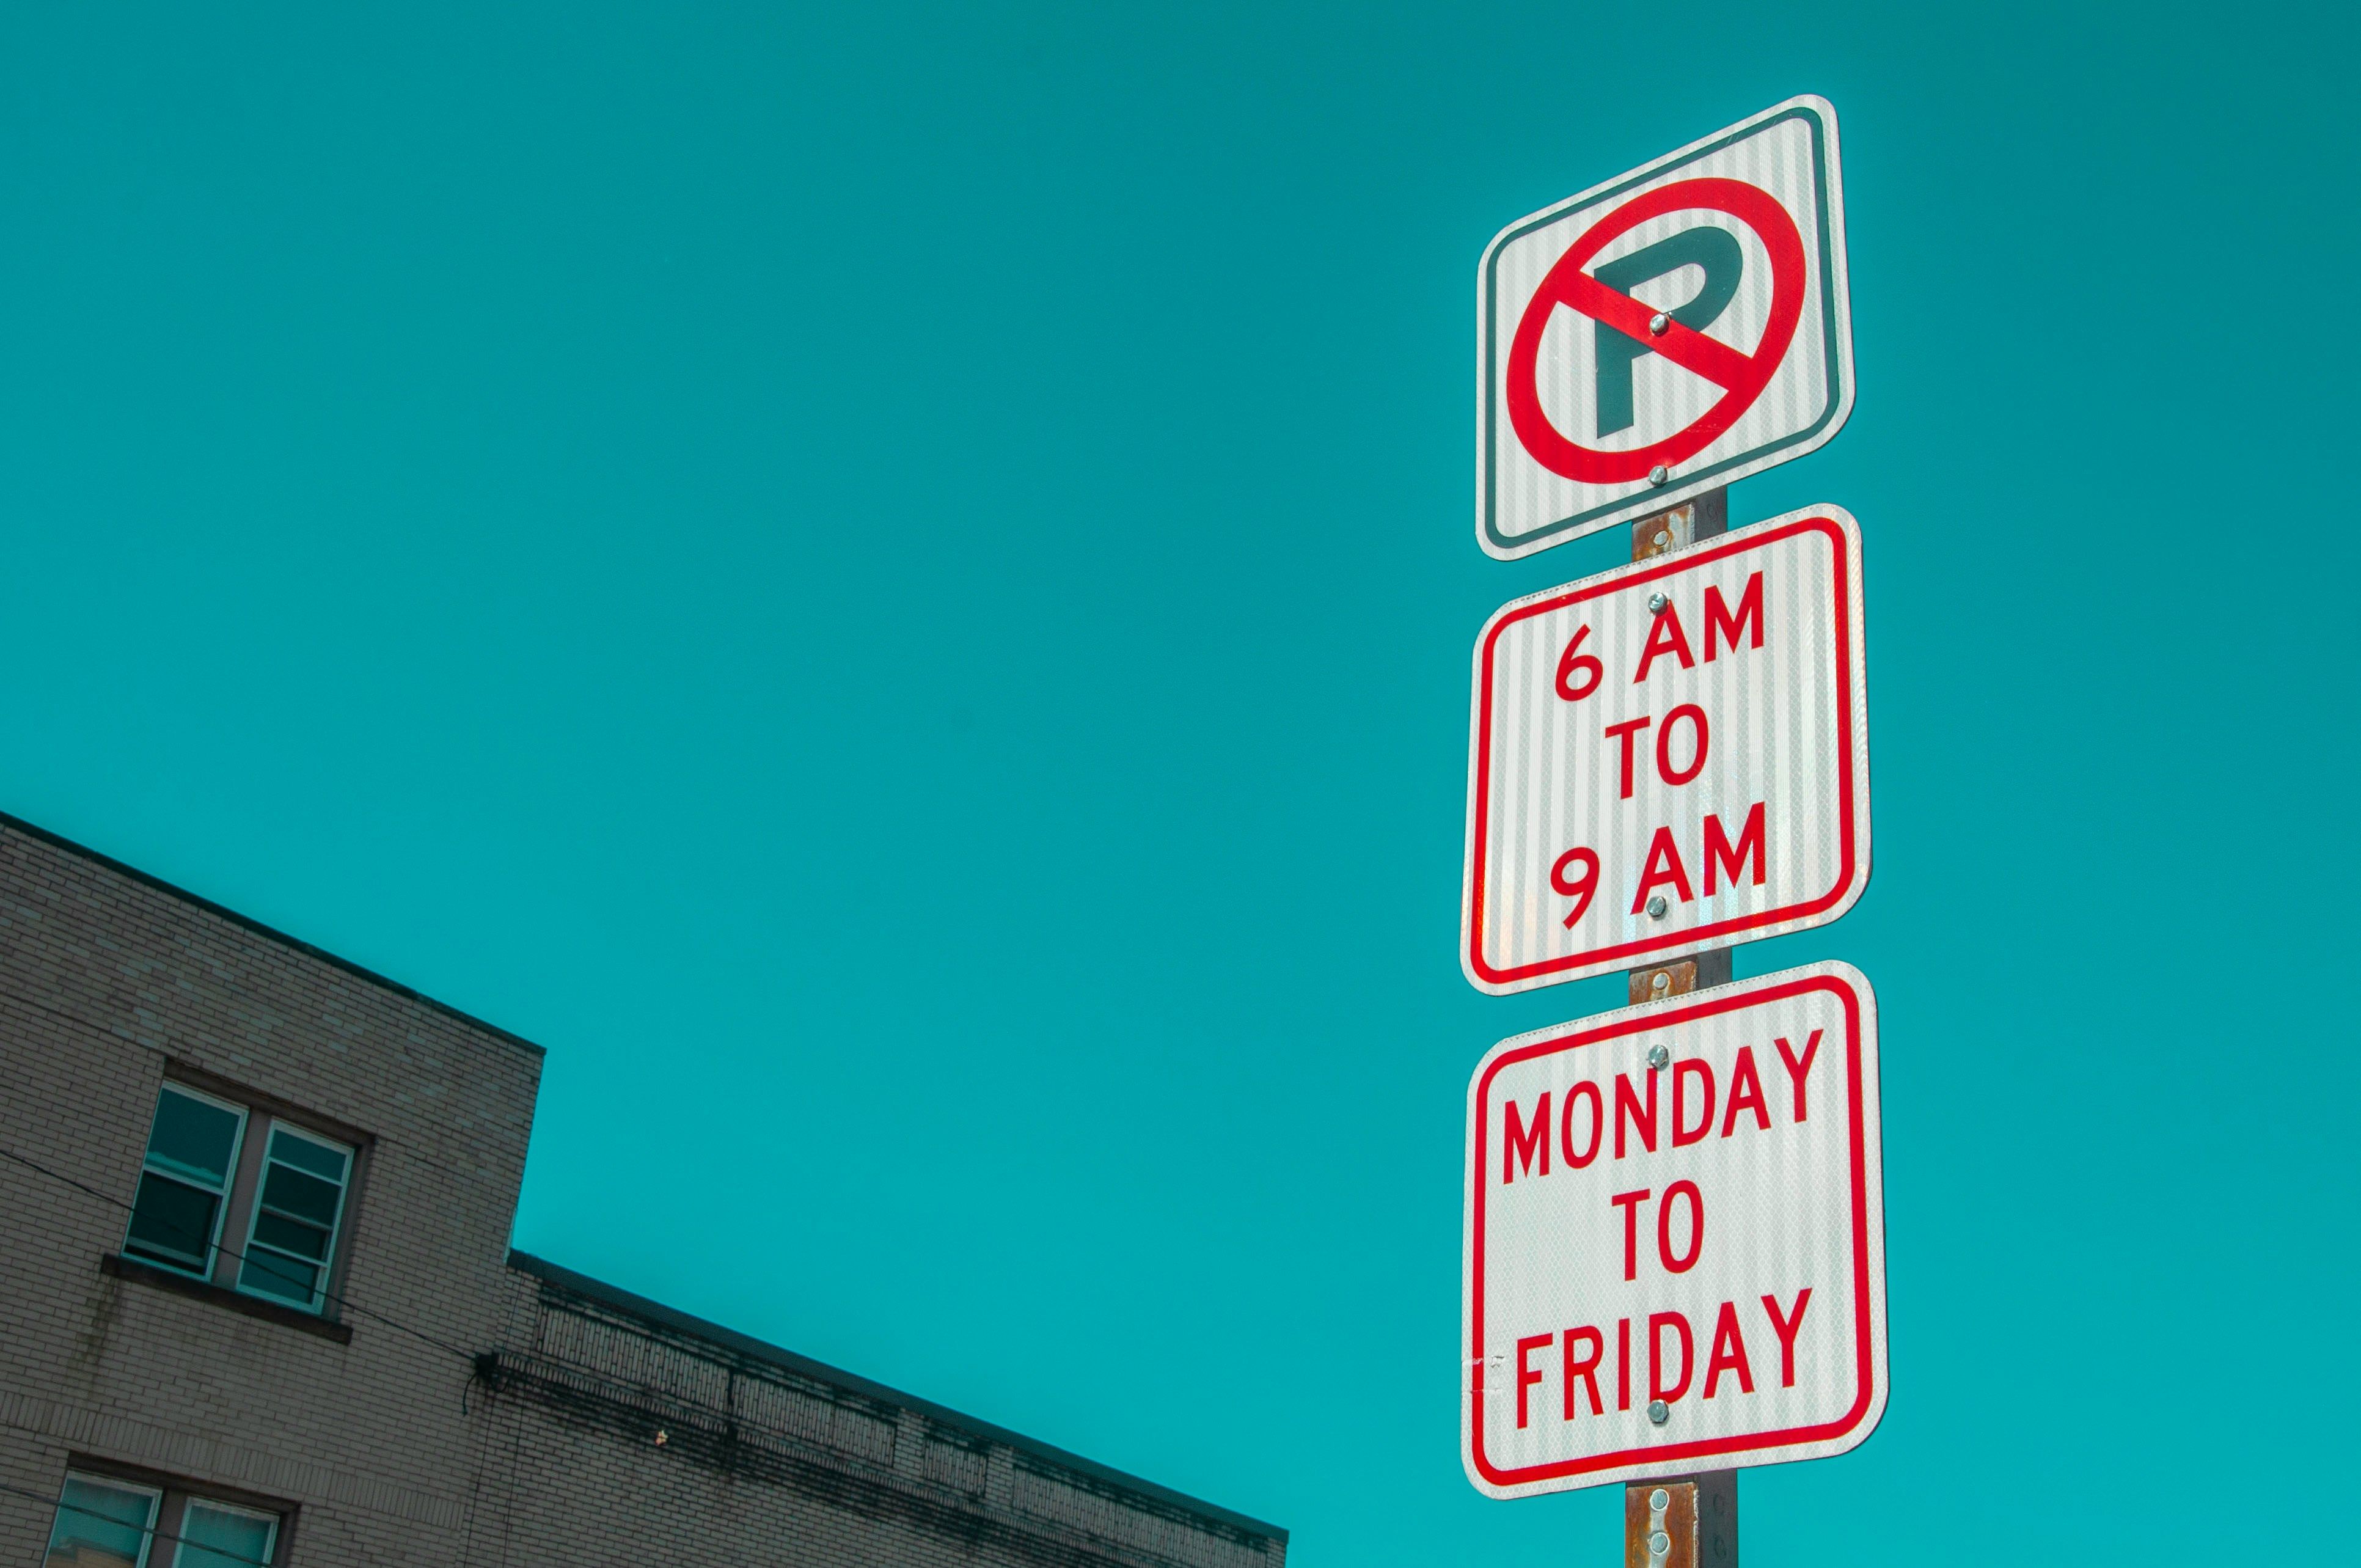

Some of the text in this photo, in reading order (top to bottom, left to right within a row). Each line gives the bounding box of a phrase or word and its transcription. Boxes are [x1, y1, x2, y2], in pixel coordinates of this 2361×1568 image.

[1594, 226, 1743, 440] P
[1555, 571, 1764, 702] 6 AM
[1605, 703, 1709, 799] TO
[1550, 802, 1766, 929] 9 AM
[1503, 1029, 1823, 1184] MONDAY
[1611, 1179, 1704, 1281] TO
[1517, 1288, 1812, 1429] FRIDAY
